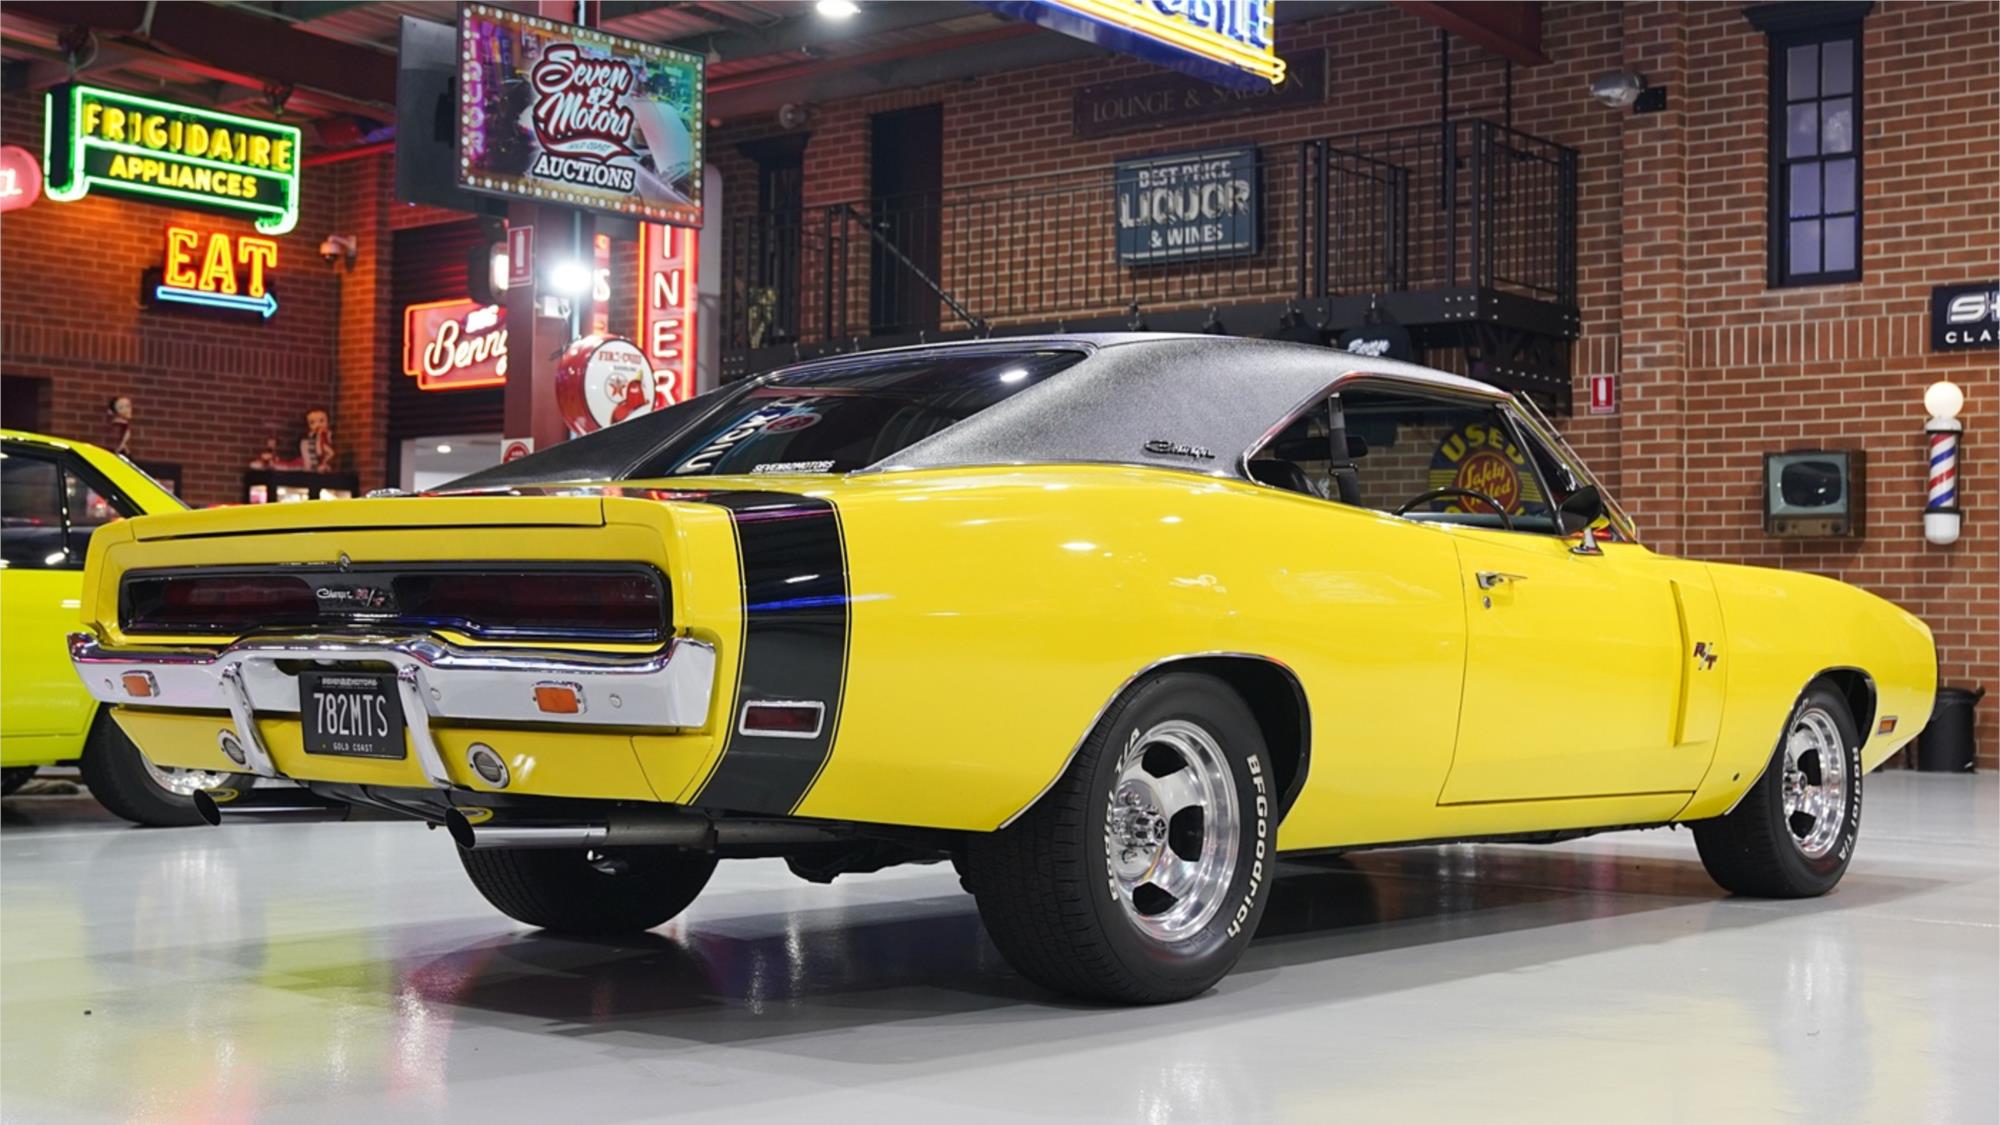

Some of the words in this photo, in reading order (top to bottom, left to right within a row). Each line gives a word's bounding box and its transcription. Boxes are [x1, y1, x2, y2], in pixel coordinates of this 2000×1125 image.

[537, 49, 630, 93] Seven
[538, 91, 631, 137] Motors
[587, 87, 614, 107] 82
[1093, 89, 1176, 123] LOUNGE
[1185, 89, 1201, 108] &
[83, 103, 293, 171] FRIGIDAIRE
[109, 155, 258, 199] APPLIANCES
[534, 155, 633, 190] AUCTIONS
[1139, 166, 1178, 188] BEST
[1182, 160, 1231, 182] PRICE
[1120, 180, 1250, 228] LIQUOR
[1149, 229, 1162, 248] &
[1167, 222, 1224, 246] WINES
[165, 227, 278, 297] EAT
[1945, 329, 1999, 344] CLA
[1693, 642, 1717, 670] R/T
[313, 692, 389, 738] 782MTS
[333, 742, 350, 751] GOLD
[352, 743, 374, 753] COAST
[1226, 754, 1268, 940] BFGoodrich
